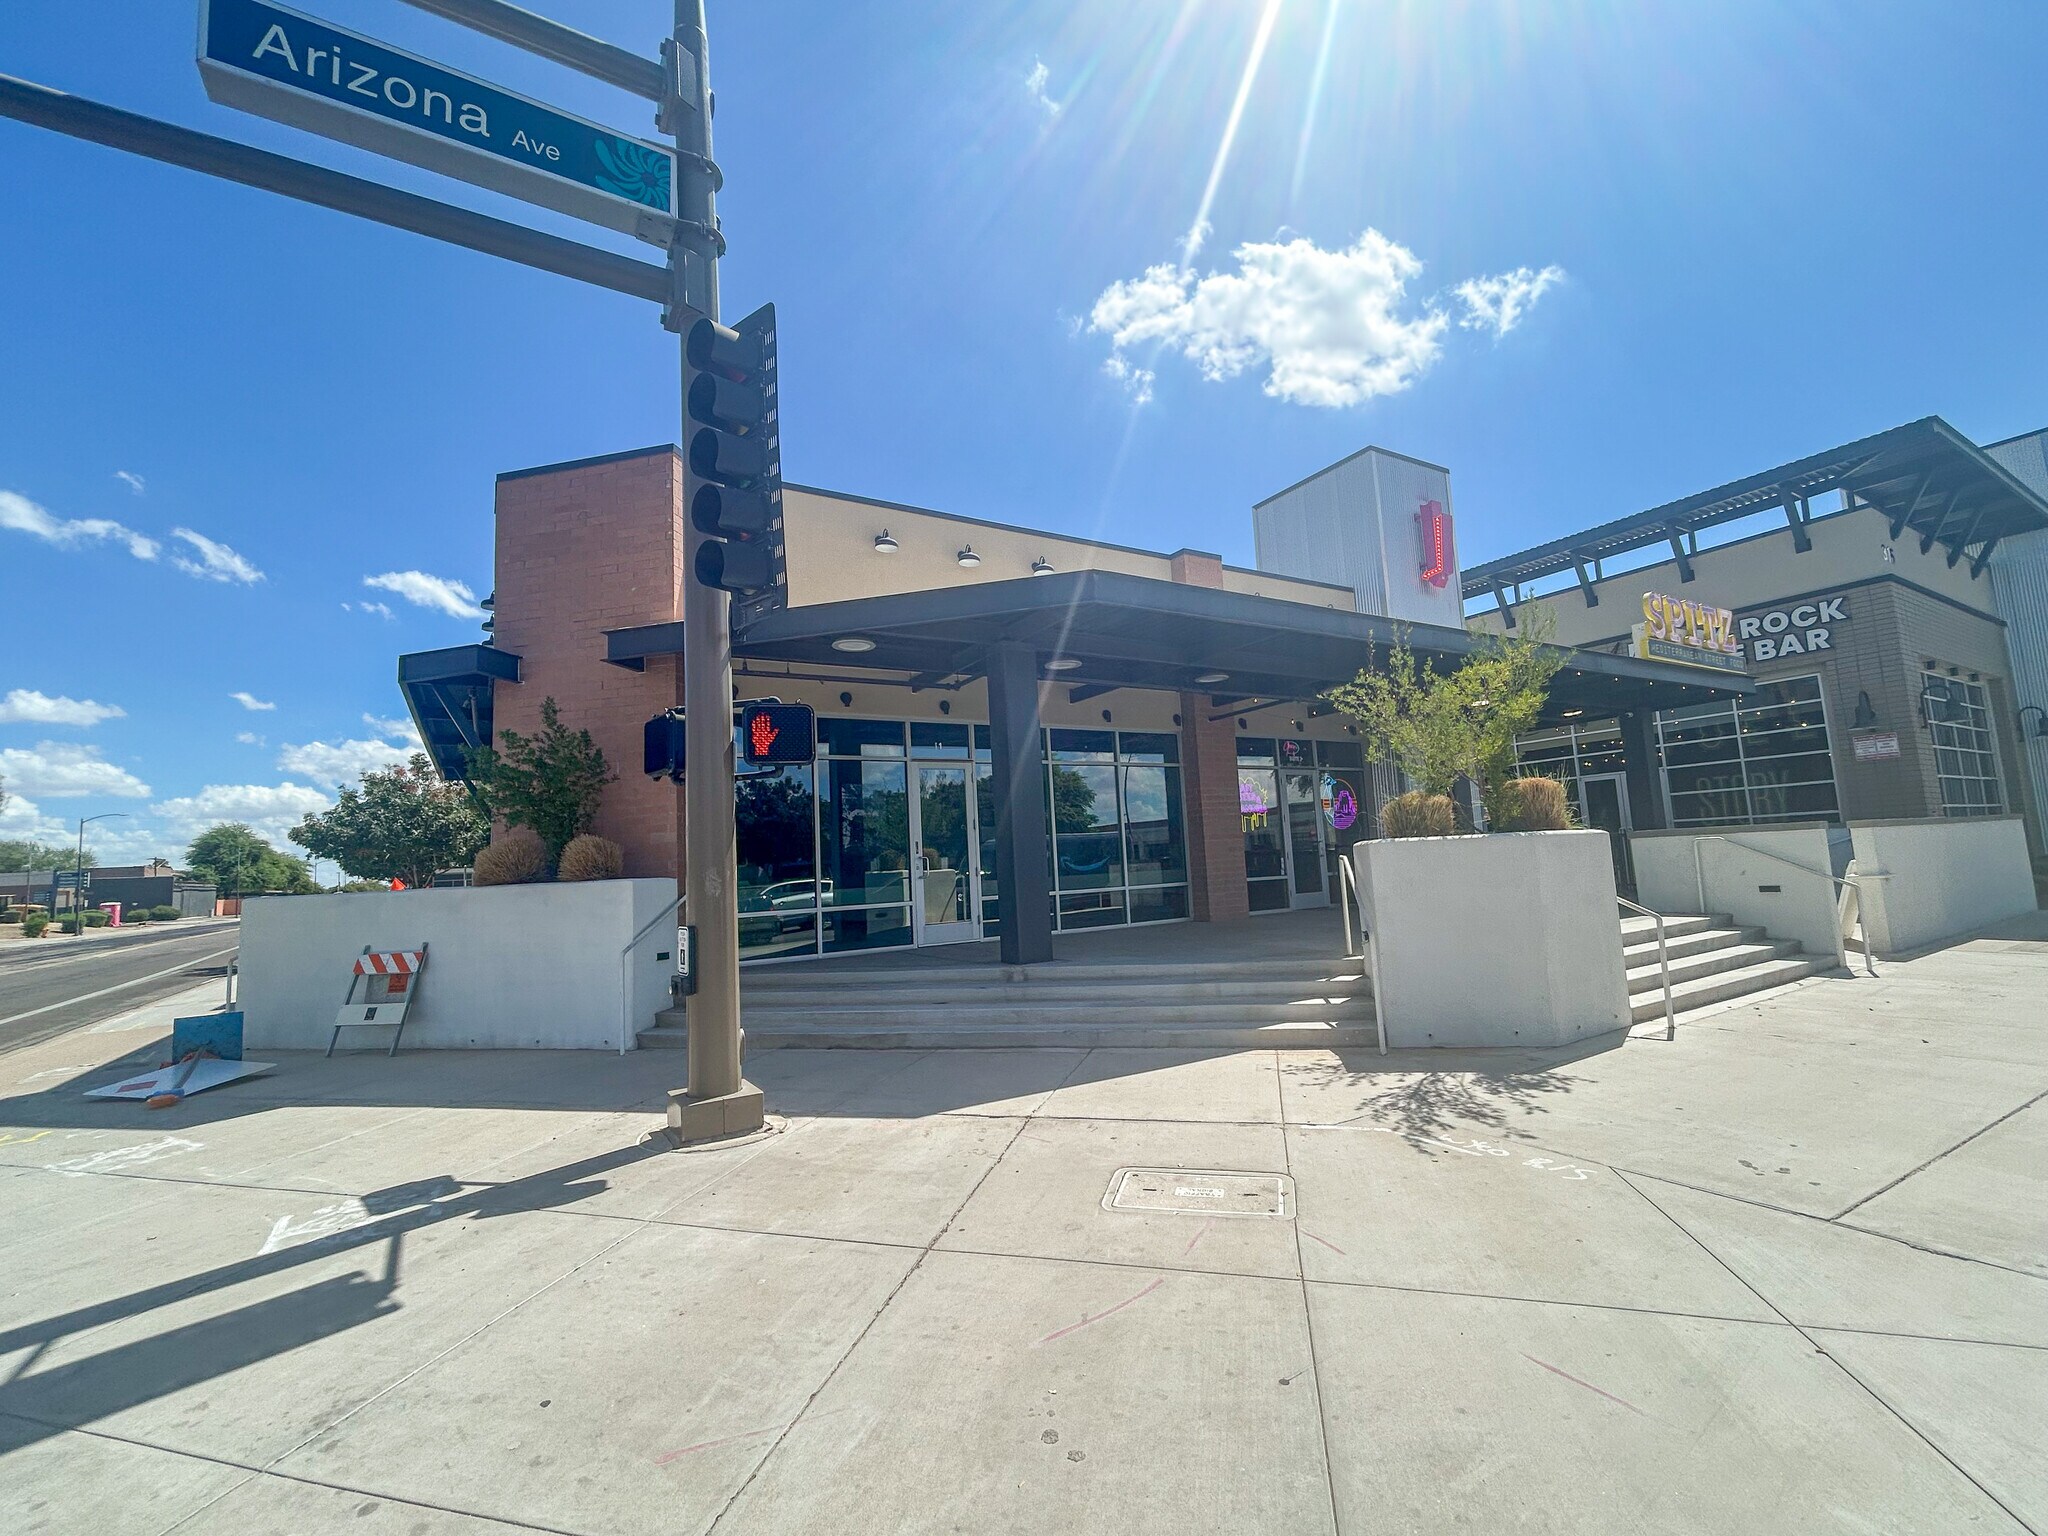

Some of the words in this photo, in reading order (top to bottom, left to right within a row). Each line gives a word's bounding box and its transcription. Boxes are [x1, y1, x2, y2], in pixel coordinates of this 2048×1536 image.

[252, 23, 491, 138] Arizona
[511, 129, 561, 161] Ave
[1643, 591, 1736, 653] SPITZ
[1739, 597, 1847, 640] ROCK
[1705, 653, 1726, 667] STREET
[1753, 628, 1830, 662] BAR
